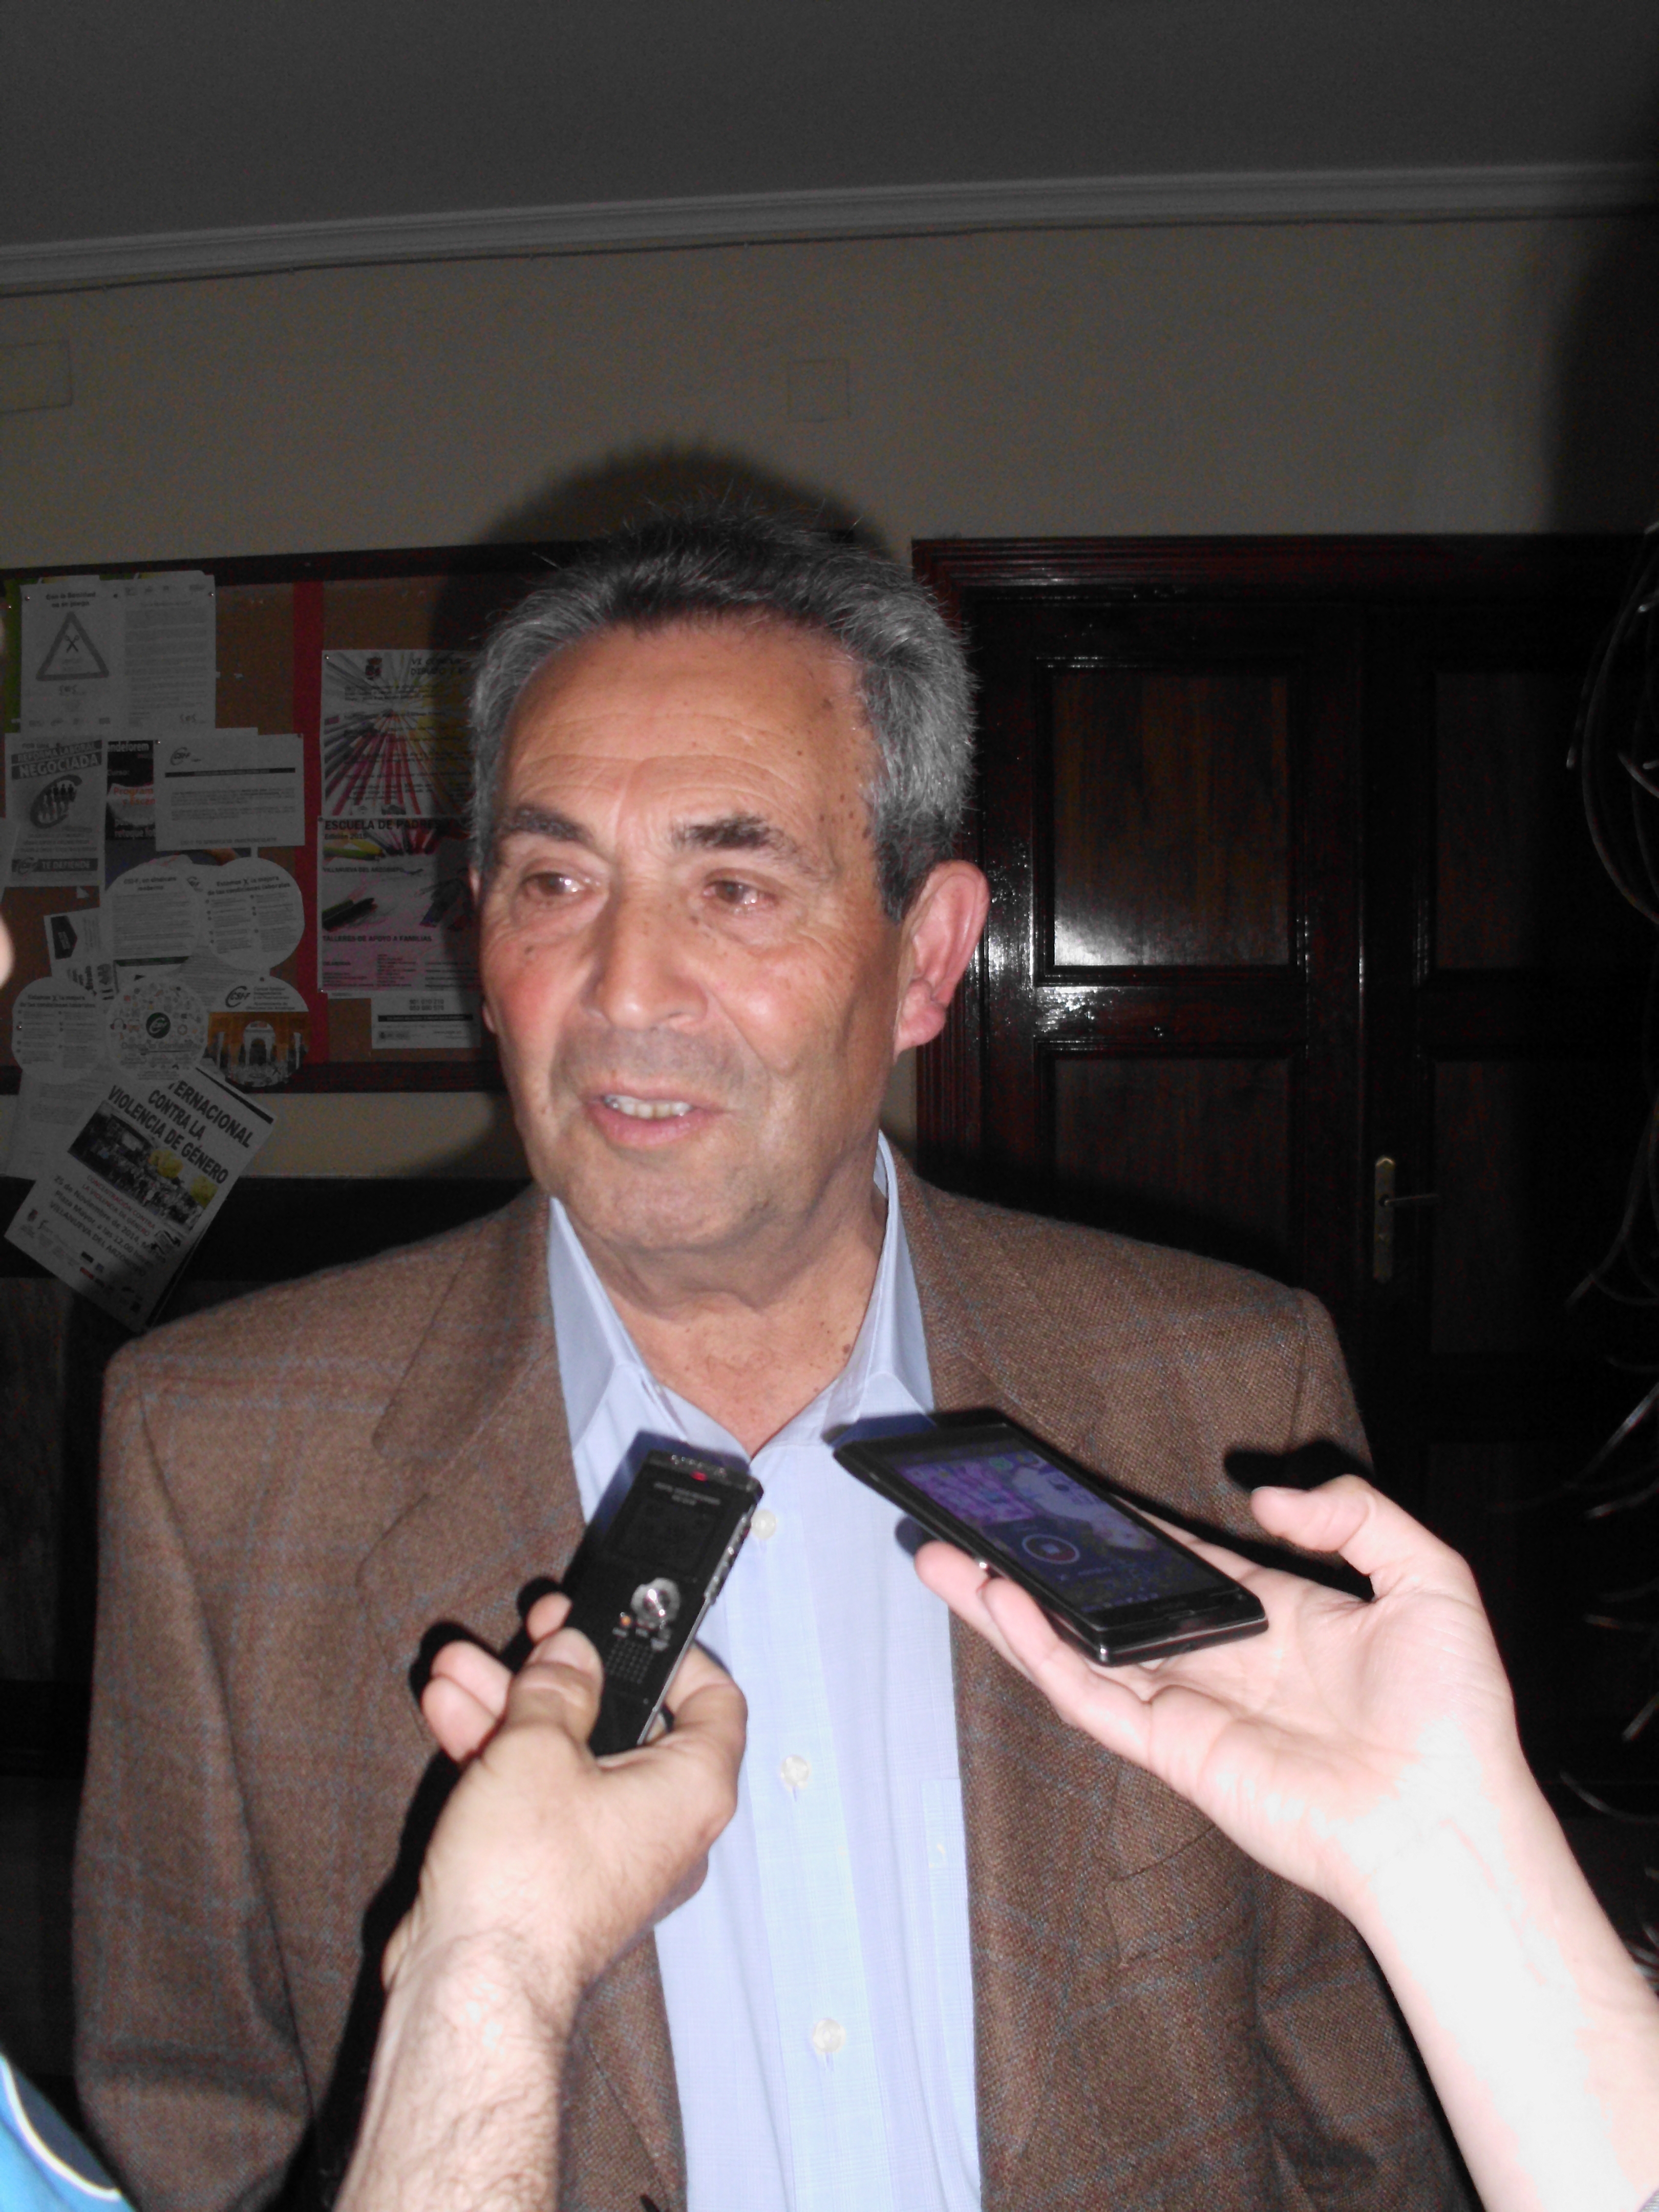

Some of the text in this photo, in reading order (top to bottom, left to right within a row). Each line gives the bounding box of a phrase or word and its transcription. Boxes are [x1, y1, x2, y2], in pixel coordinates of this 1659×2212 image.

[17, 742, 96, 762] REFORMA LABORAL
[19, 753, 98, 778] NEGOCIADA
[325, 820, 375, 830] ESCUELA
[378, 819, 392, 830] DE
[53, 861, 90, 869] DEFIENDE
[108, 1084, 167, 1138] VIOLENCIA
[164, 1129, 185, 1150] DE
[181, 1144, 229, 1184] GÉNERO
[147, 1090, 188, 1129] CONTRA
[188, 1121, 205, 1141] LA
[50, 1201, 92, 1236] VILLANUEVA
[92, 1234, 106, 1247] DEL
[54, 1175, 65, 1185] 25
[64, 1183, 74, 1192] de
[74, 1190, 112, 1221] Noviembre
[111, 1219, 121, 1228] de
[55, 1190, 74, 1207] Plaza
[102, 1227, 114, 1238] las
[87, 1175, 156, 1229] CONCENTRACIÓN CONTRA
[91, 1190, 118, 1213] VIOLENCIA
[127, 1217, 150, 1237] GÉNERO
